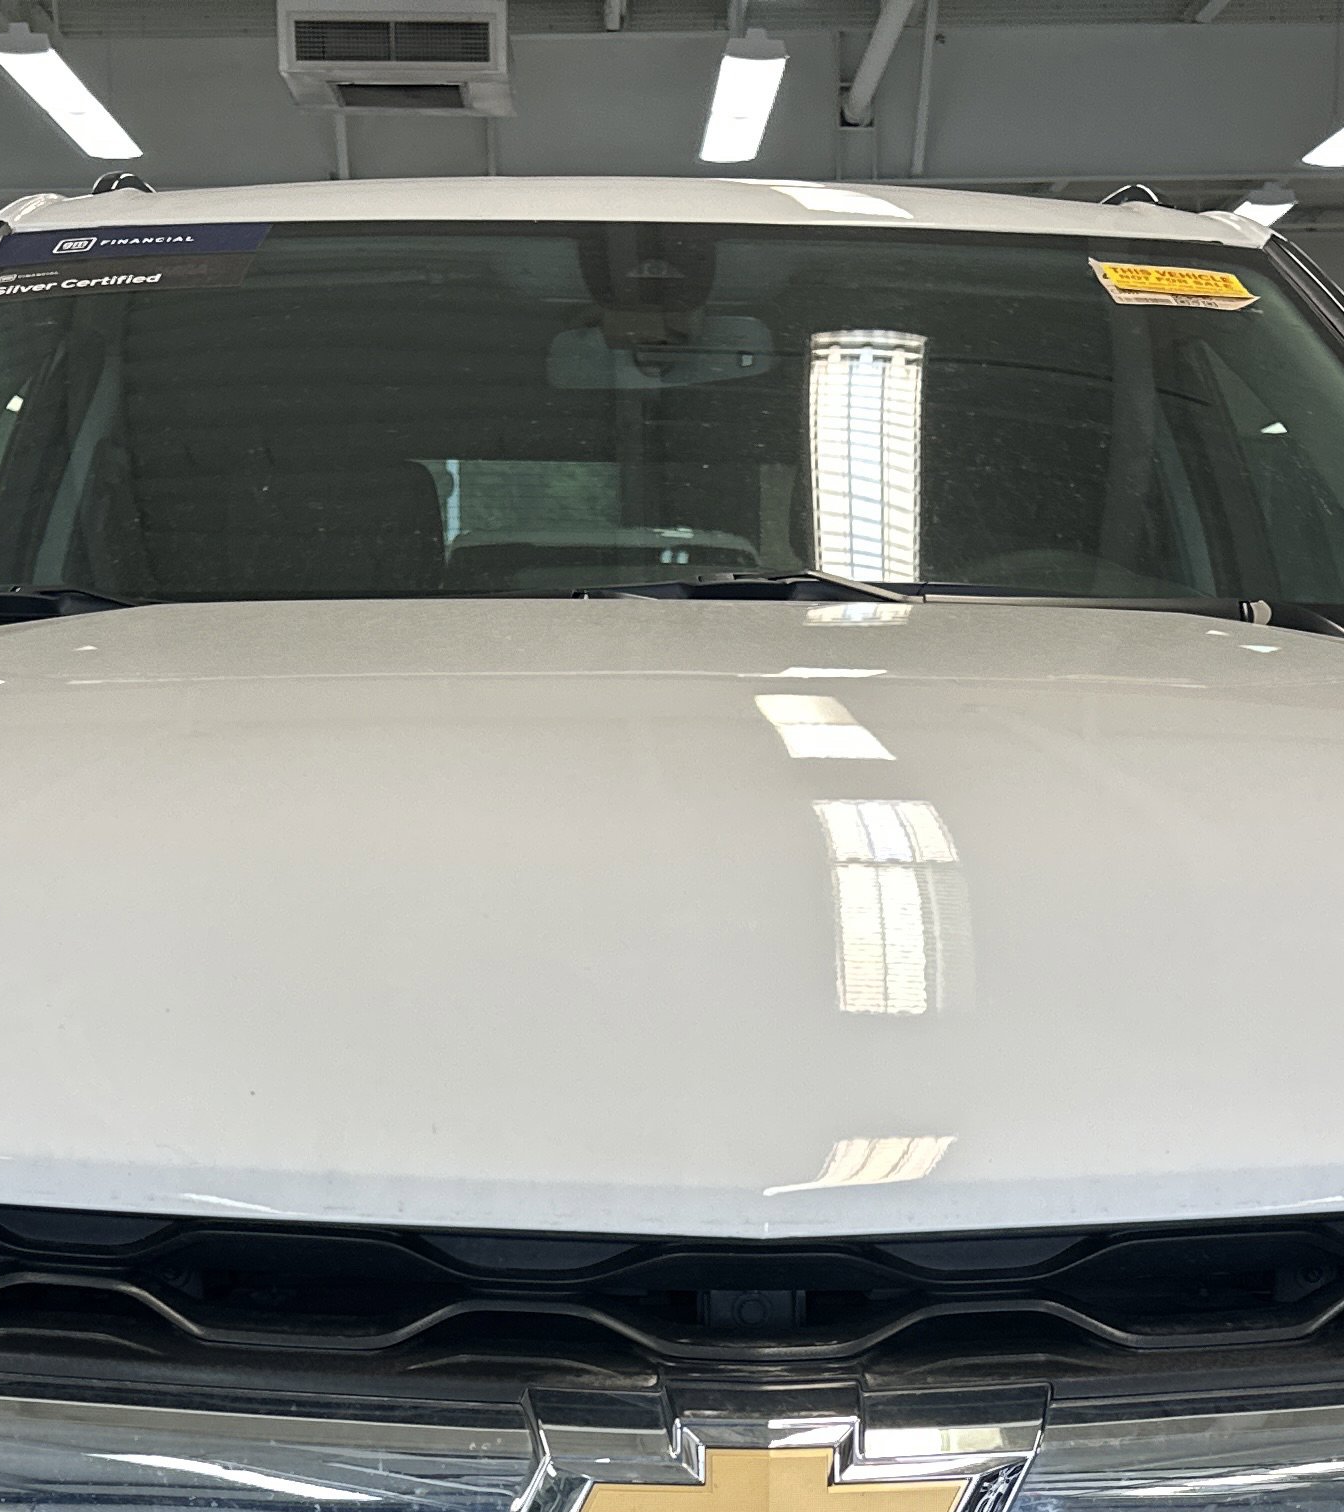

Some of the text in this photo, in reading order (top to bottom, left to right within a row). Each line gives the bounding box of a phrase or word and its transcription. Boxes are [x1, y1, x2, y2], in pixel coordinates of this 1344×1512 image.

[99, 236, 195, 246] FINANCIAL
[1111, 266, 1152, 276] THIS
[61, 273, 163, 289] Certified
